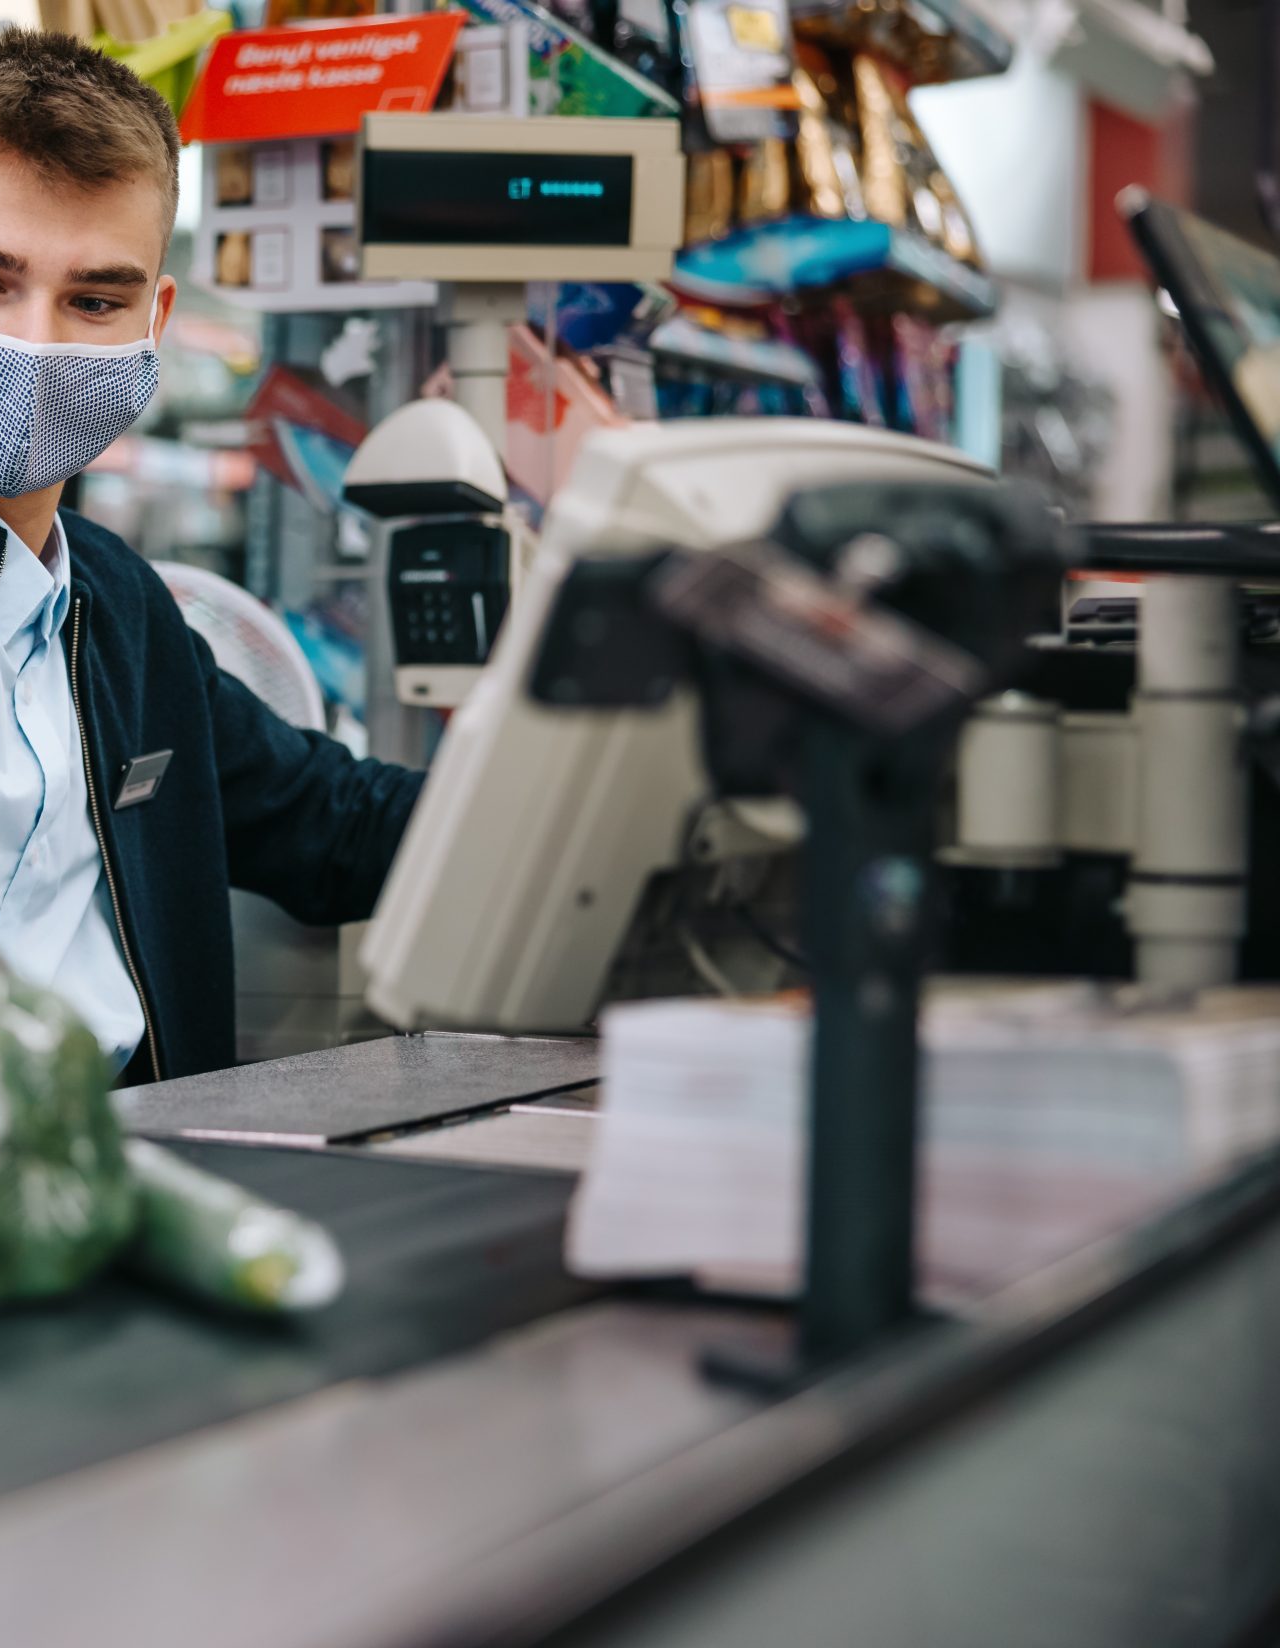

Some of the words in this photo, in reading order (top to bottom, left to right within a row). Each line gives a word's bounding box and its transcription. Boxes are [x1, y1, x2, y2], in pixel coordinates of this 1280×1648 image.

[237, 42, 313, 68] Benyt
[316, 32, 419, 60] venligst
[225, 70, 304, 95] næste
[308, 63, 384, 87] kasse
